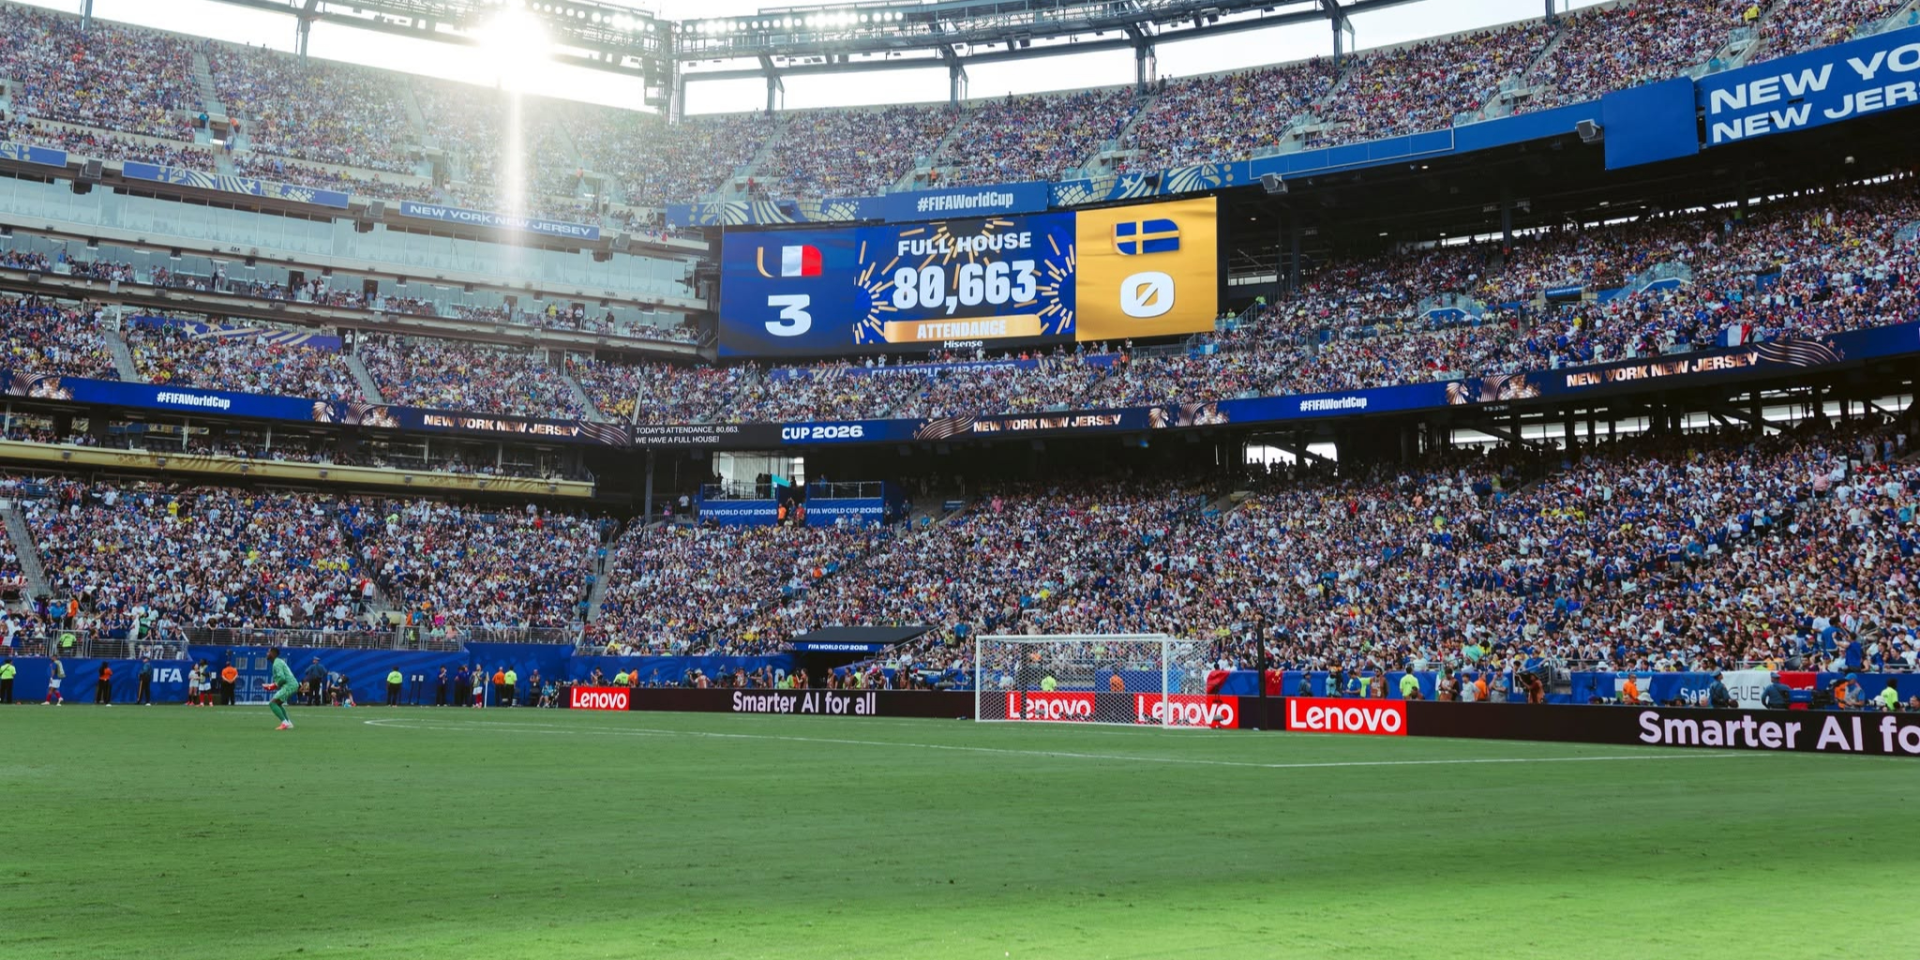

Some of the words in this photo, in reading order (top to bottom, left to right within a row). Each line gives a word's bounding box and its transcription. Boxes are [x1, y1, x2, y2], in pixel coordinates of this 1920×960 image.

[1710, 63, 1834, 114] NEW
[1846, 42, 1920, 81] YO
[1712, 103, 1812, 143] NEW
[1823, 80, 1920, 119] JER
[917, 192, 1014, 212] #FIFAWorldCup
[410, 205, 446, 217] NEW
[450, 210, 491, 223] YORK
[495, 217, 529, 228] NEW
[532, 221, 591, 236] JERSEY
[898, 238, 950, 256] FULL
[957, 232, 1032, 253] HOUSE
[892, 259, 1037, 315] 80,663
[1120, 271, 1175, 318] 0
[765, 294, 812, 336] 3
[917, 319, 1006, 339] ATTENDANCE
[943, 339, 983, 349] Hisense
[1566, 373, 1602, 387] NEW
[1605, 365, 1649, 382] YORK
[1651, 360, 1689, 377] NEW
[1691, 352, 1759, 372] JERSEY
[156, 391, 231, 410] #FIFAWorldCup
[1300, 396, 1368, 412] #FIFAWorldCup
[424, 414, 456, 427] NEW
[458, 418, 494, 430] YORK
[496, 421, 527, 433] NEW
[529, 423, 579, 437] JERSEY
[782, 427, 810, 440] CUP
[812, 425, 863, 439] 2026
[973, 421, 1001, 433] NEW
[1004, 418, 1038, 431] YORK
[1040, 416, 1070, 429] NEW
[1071, 414, 1122, 427] JERSEY
[699, 508, 714, 516] FIFA
[714, 508, 739, 516] WORLD
[739, 508, 753, 516] CUP
[807, 507, 821, 515] FIFA
[859, 506, 883, 514] 2026
[153, 668, 183, 683] IFA
[572, 692, 627, 710] Lenovo
[732, 691, 797, 713] Smarter
[801, 692, 820, 713] AI
[825, 691, 850, 714] for
[855, 692, 876, 715] all
[1009, 693, 1092, 719] Lenovo
[1138, 695, 1234, 725] Lenovo
[1290, 699, 1401, 732] Lenovo
[1638, 710, 1801, 749] Smarter
[1816, 715, 1864, 751] AI
[1879, 715, 1920, 754] fo
